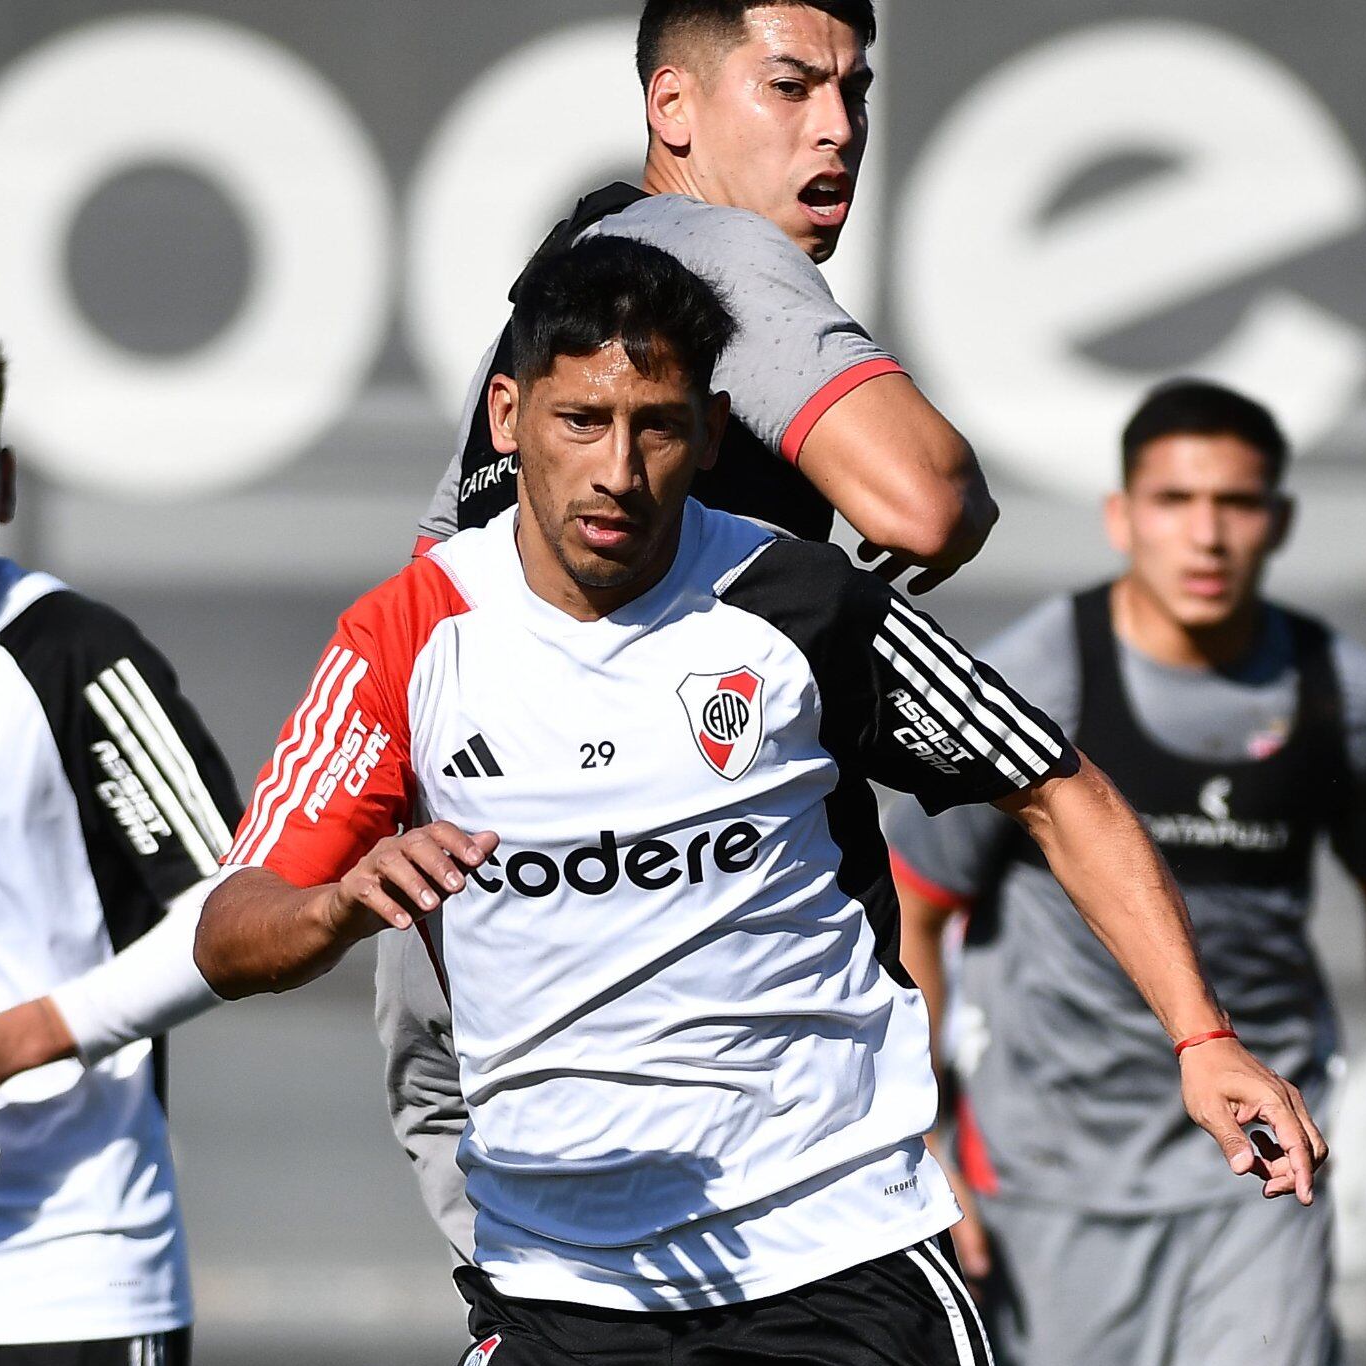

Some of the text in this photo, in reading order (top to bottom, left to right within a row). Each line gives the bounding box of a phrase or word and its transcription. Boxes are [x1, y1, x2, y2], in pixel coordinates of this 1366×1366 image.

[460, 454, 519, 503] CATAPU
[702, 692, 750, 741] CARP
[886, 687, 975, 763] ASSIST
[303, 708, 368, 823] ASSIST
[579, 740, 616, 769] 29
[892, 726, 961, 774] CARD
[469, 820, 762, 898] codere
